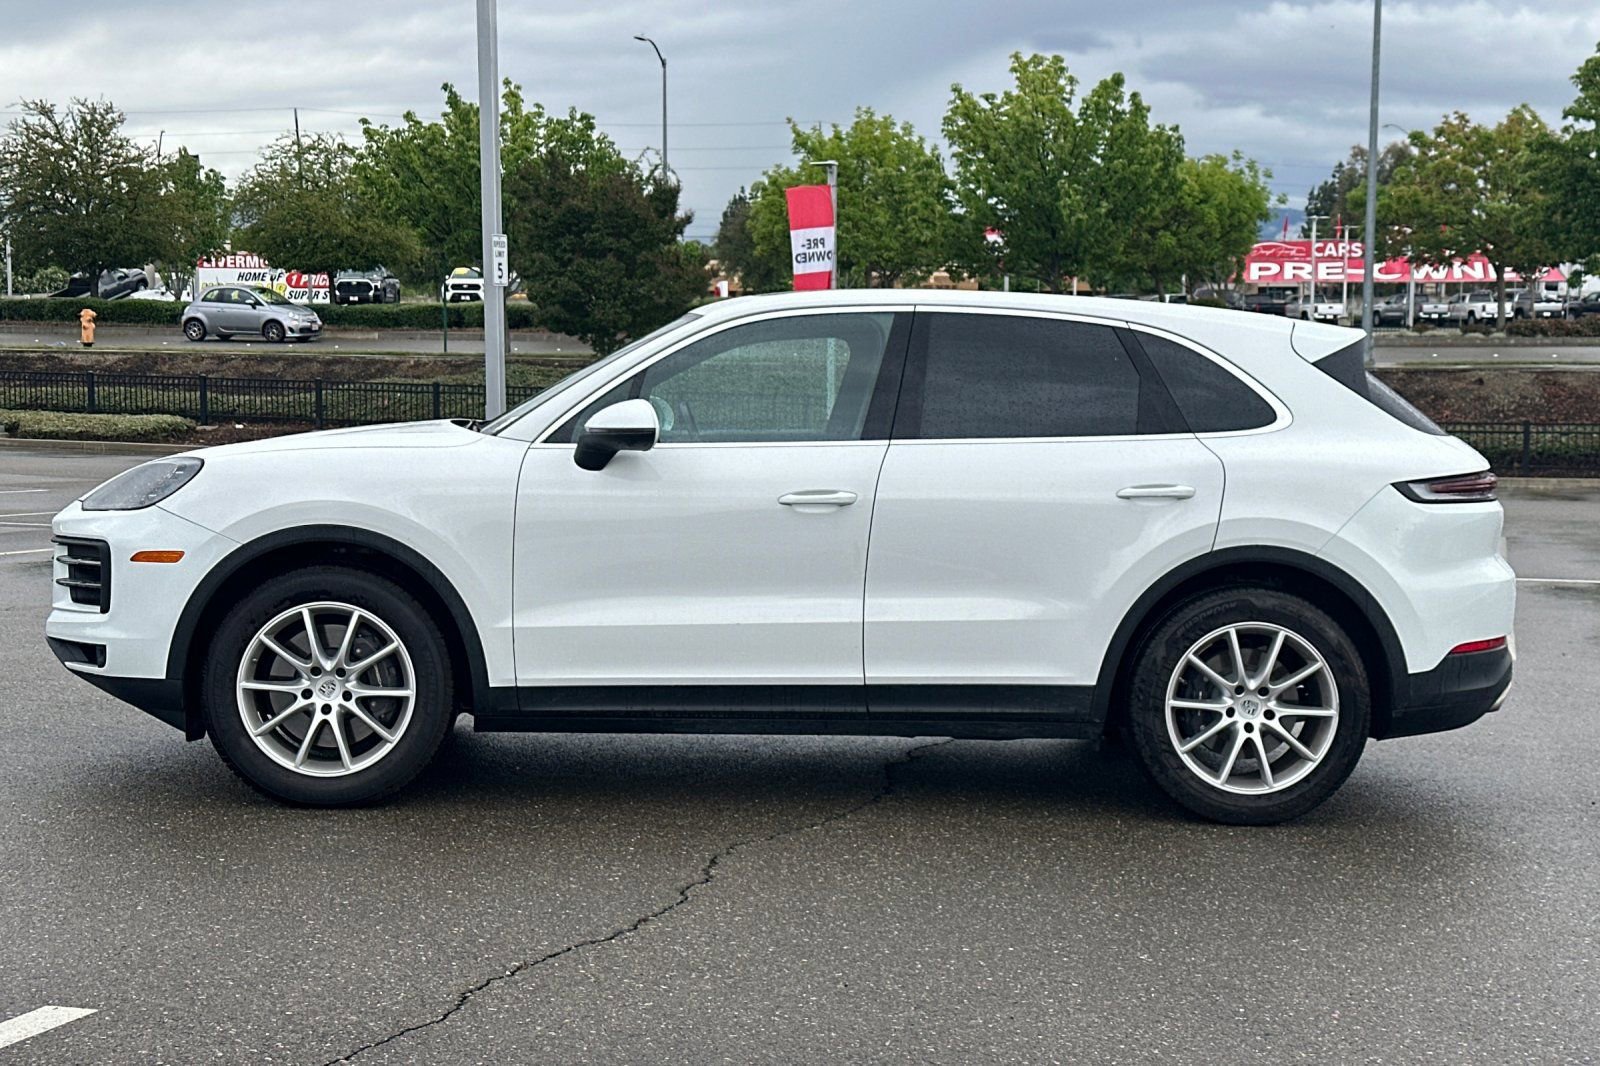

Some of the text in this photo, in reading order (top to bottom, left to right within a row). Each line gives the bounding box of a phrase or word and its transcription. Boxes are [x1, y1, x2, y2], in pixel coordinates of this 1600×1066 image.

[1314, 242, 1363, 257] CARS
[497, 262, 504, 279] 5
[237, 272, 268, 282] HOME
[291, 274, 297, 283] 1
[300, 274, 330, 283] PRIC
[287, 290, 320, 300] SUPR
